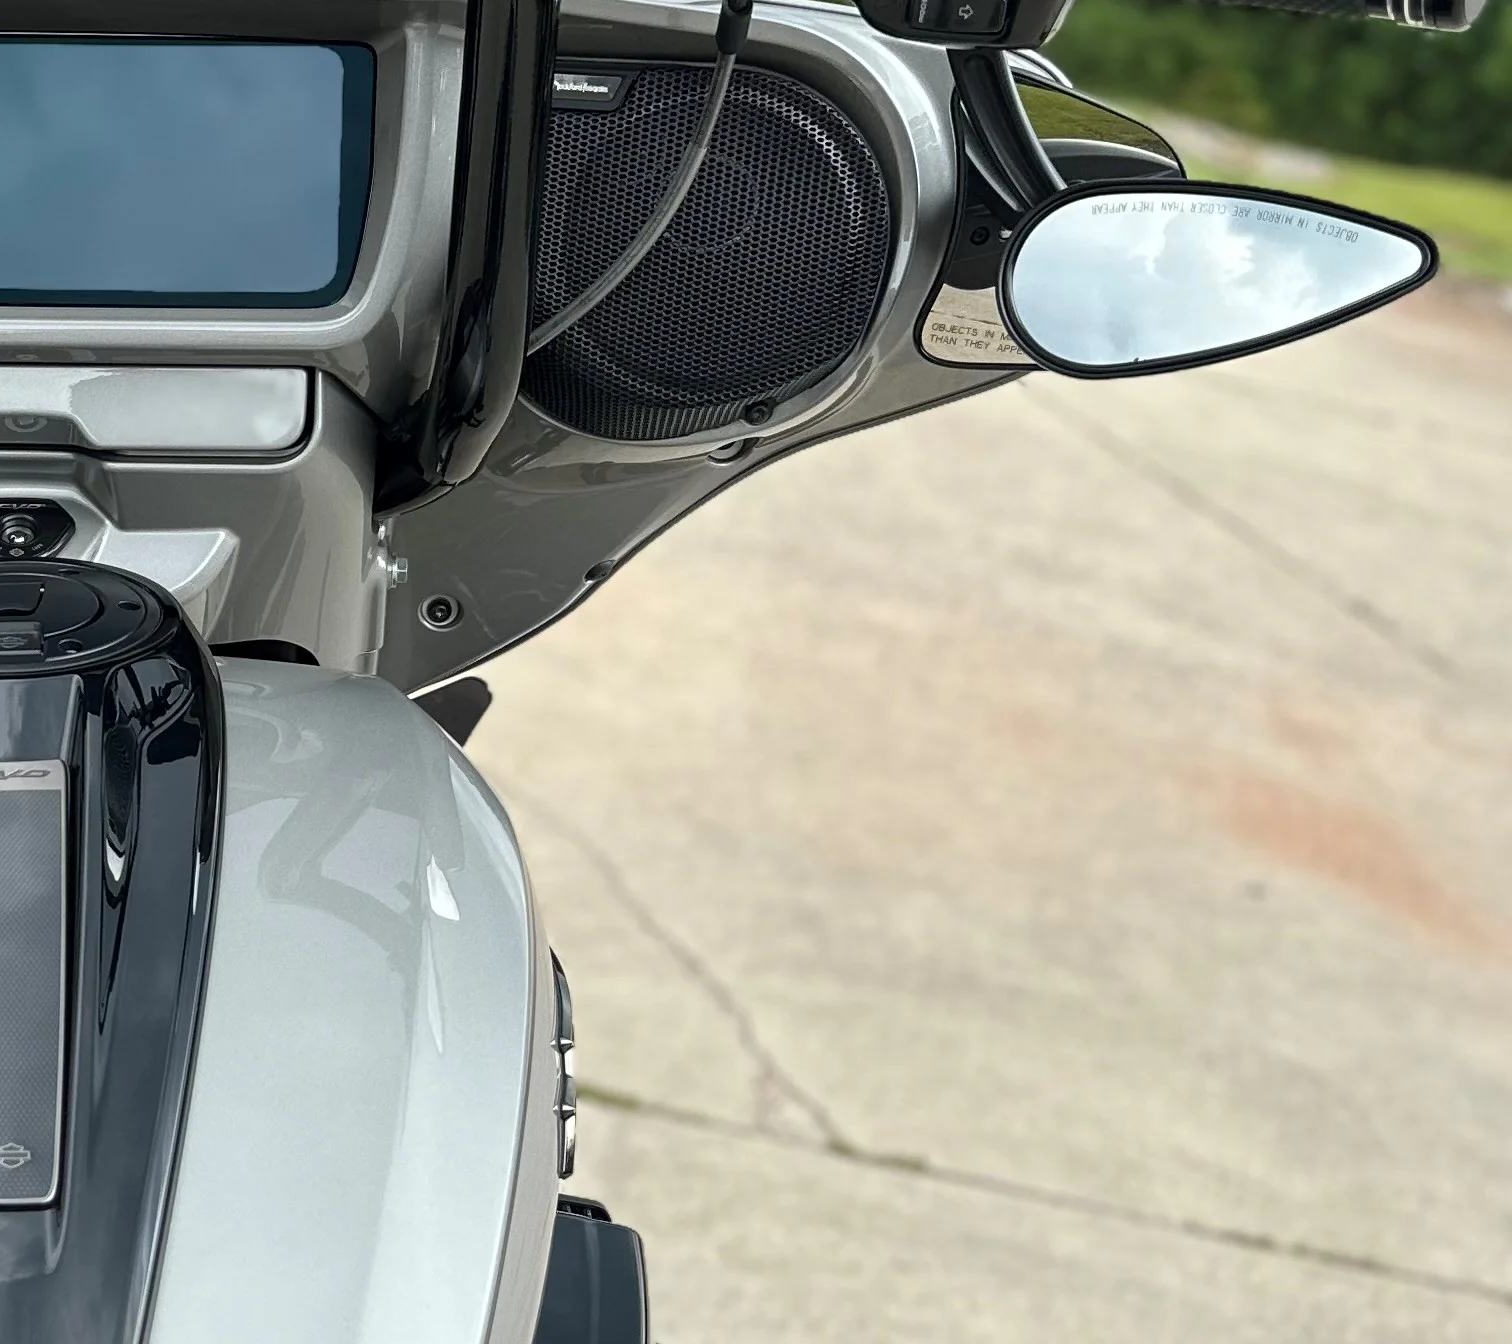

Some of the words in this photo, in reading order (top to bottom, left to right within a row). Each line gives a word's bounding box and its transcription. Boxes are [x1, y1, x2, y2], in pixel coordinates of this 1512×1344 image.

[1091, 201, 1127, 215] APPEAR
[1131, 201, 1155, 212] THEY
[1160, 201, 1185, 213] THAN
[1191, 202, 1227, 215] CLOSER
[1232, 206, 1251, 218] ARE
[1256, 209, 1293, 226] MIRROR
[1297, 218, 1309, 229] IN
[1316, 221, 1359, 243] OBJECTS
[931, 322, 978, 336] OBJECTS
[984, 329, 995, 339] IN
[929, 334, 958, 346] THAN
[964, 338, 991, 350] THEY
